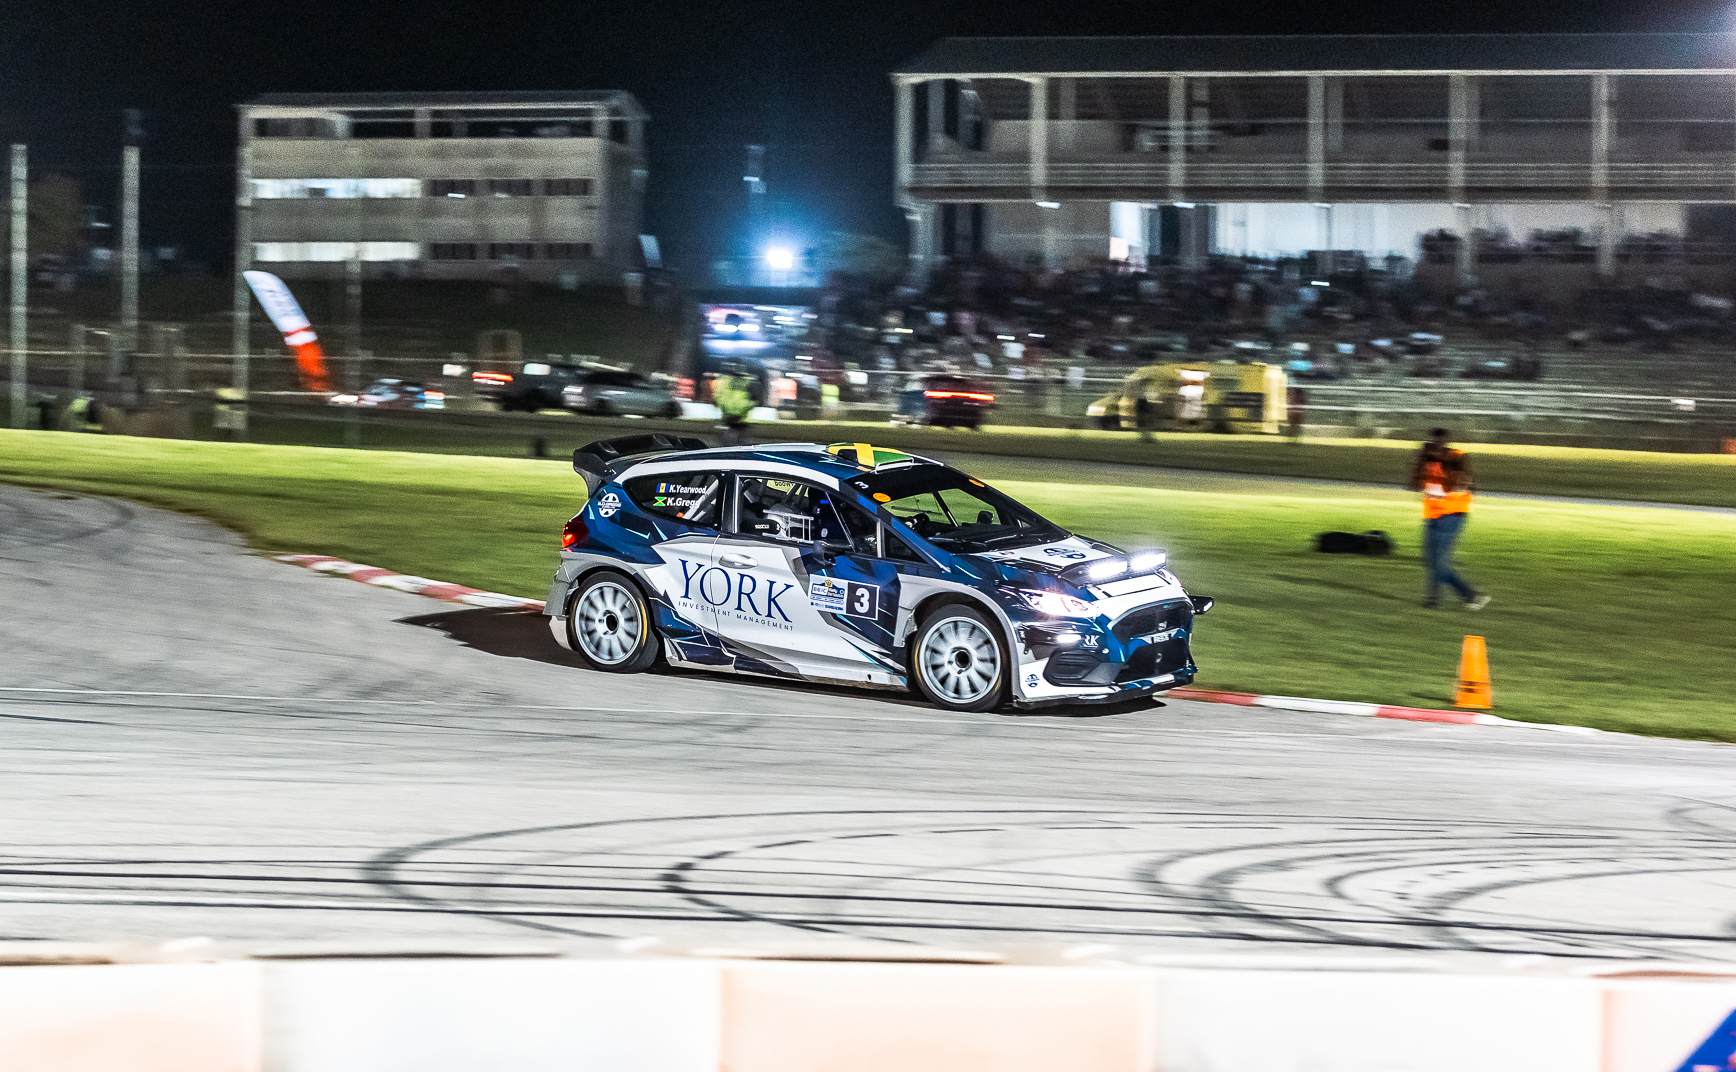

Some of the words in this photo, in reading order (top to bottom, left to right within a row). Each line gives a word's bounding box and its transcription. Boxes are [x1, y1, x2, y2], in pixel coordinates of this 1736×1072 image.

[669, 484, 707, 494] K.Yearwood
[854, 481, 870, 489] 3
[666, 497, 700, 508] K.Gregg
[678, 558, 794, 623] YORK
[854, 587, 870, 614] 3
[678, 601, 731, 617] INVESTMENT
[736, 613, 794, 631] MANAGEMENT
